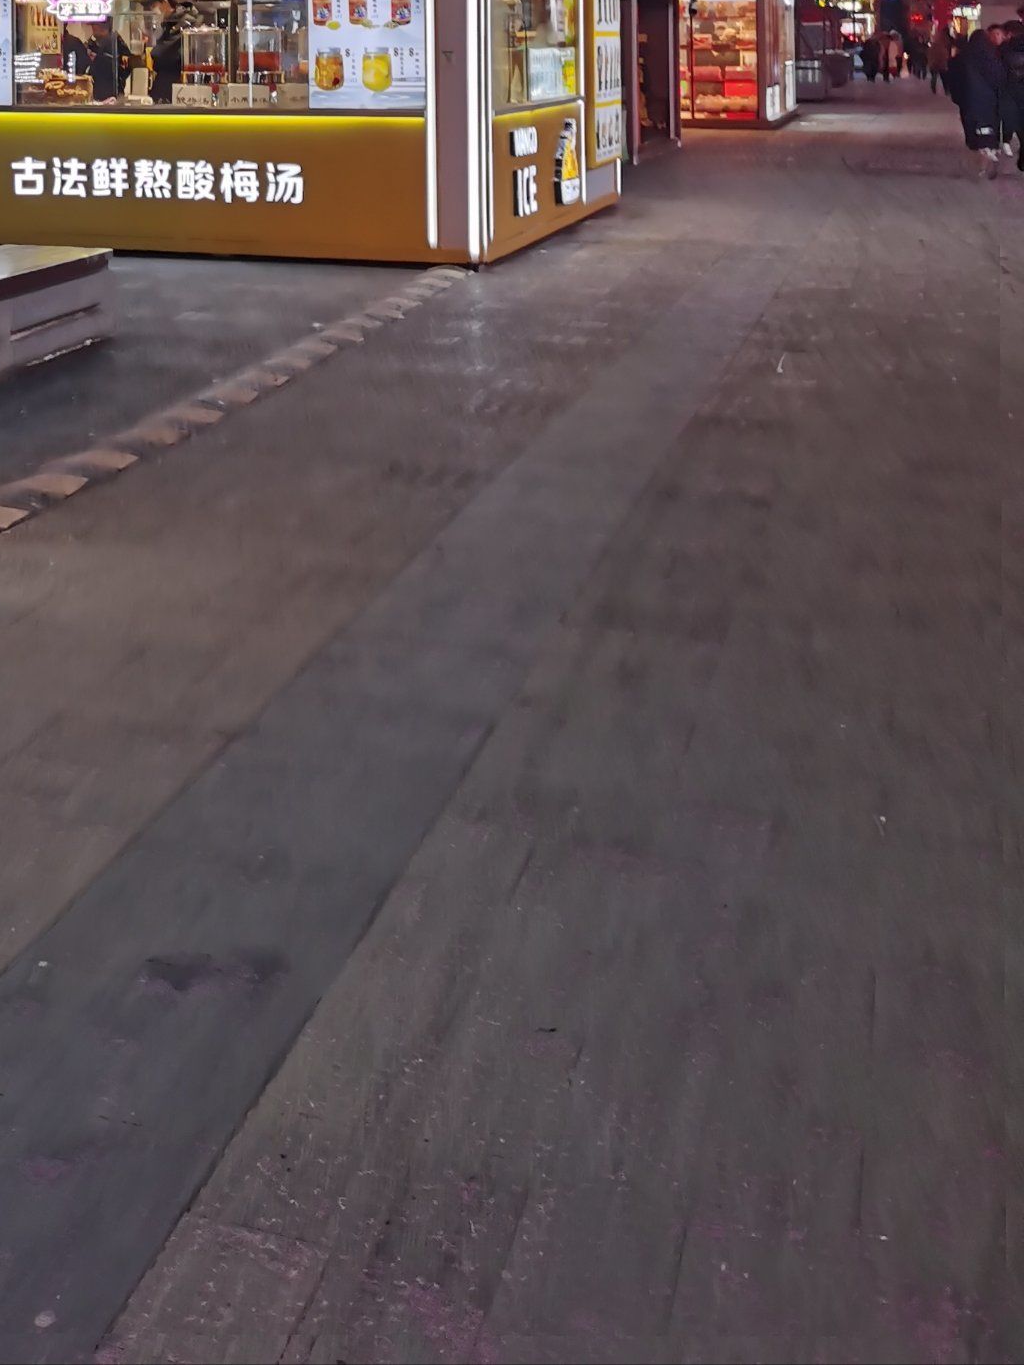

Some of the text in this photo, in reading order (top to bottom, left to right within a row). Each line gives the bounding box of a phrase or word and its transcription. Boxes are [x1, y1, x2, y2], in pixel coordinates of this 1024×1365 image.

[11, 157, 304, 204] 古法鲜熬酸梅汤
[515, 164, 538, 218] ICE
